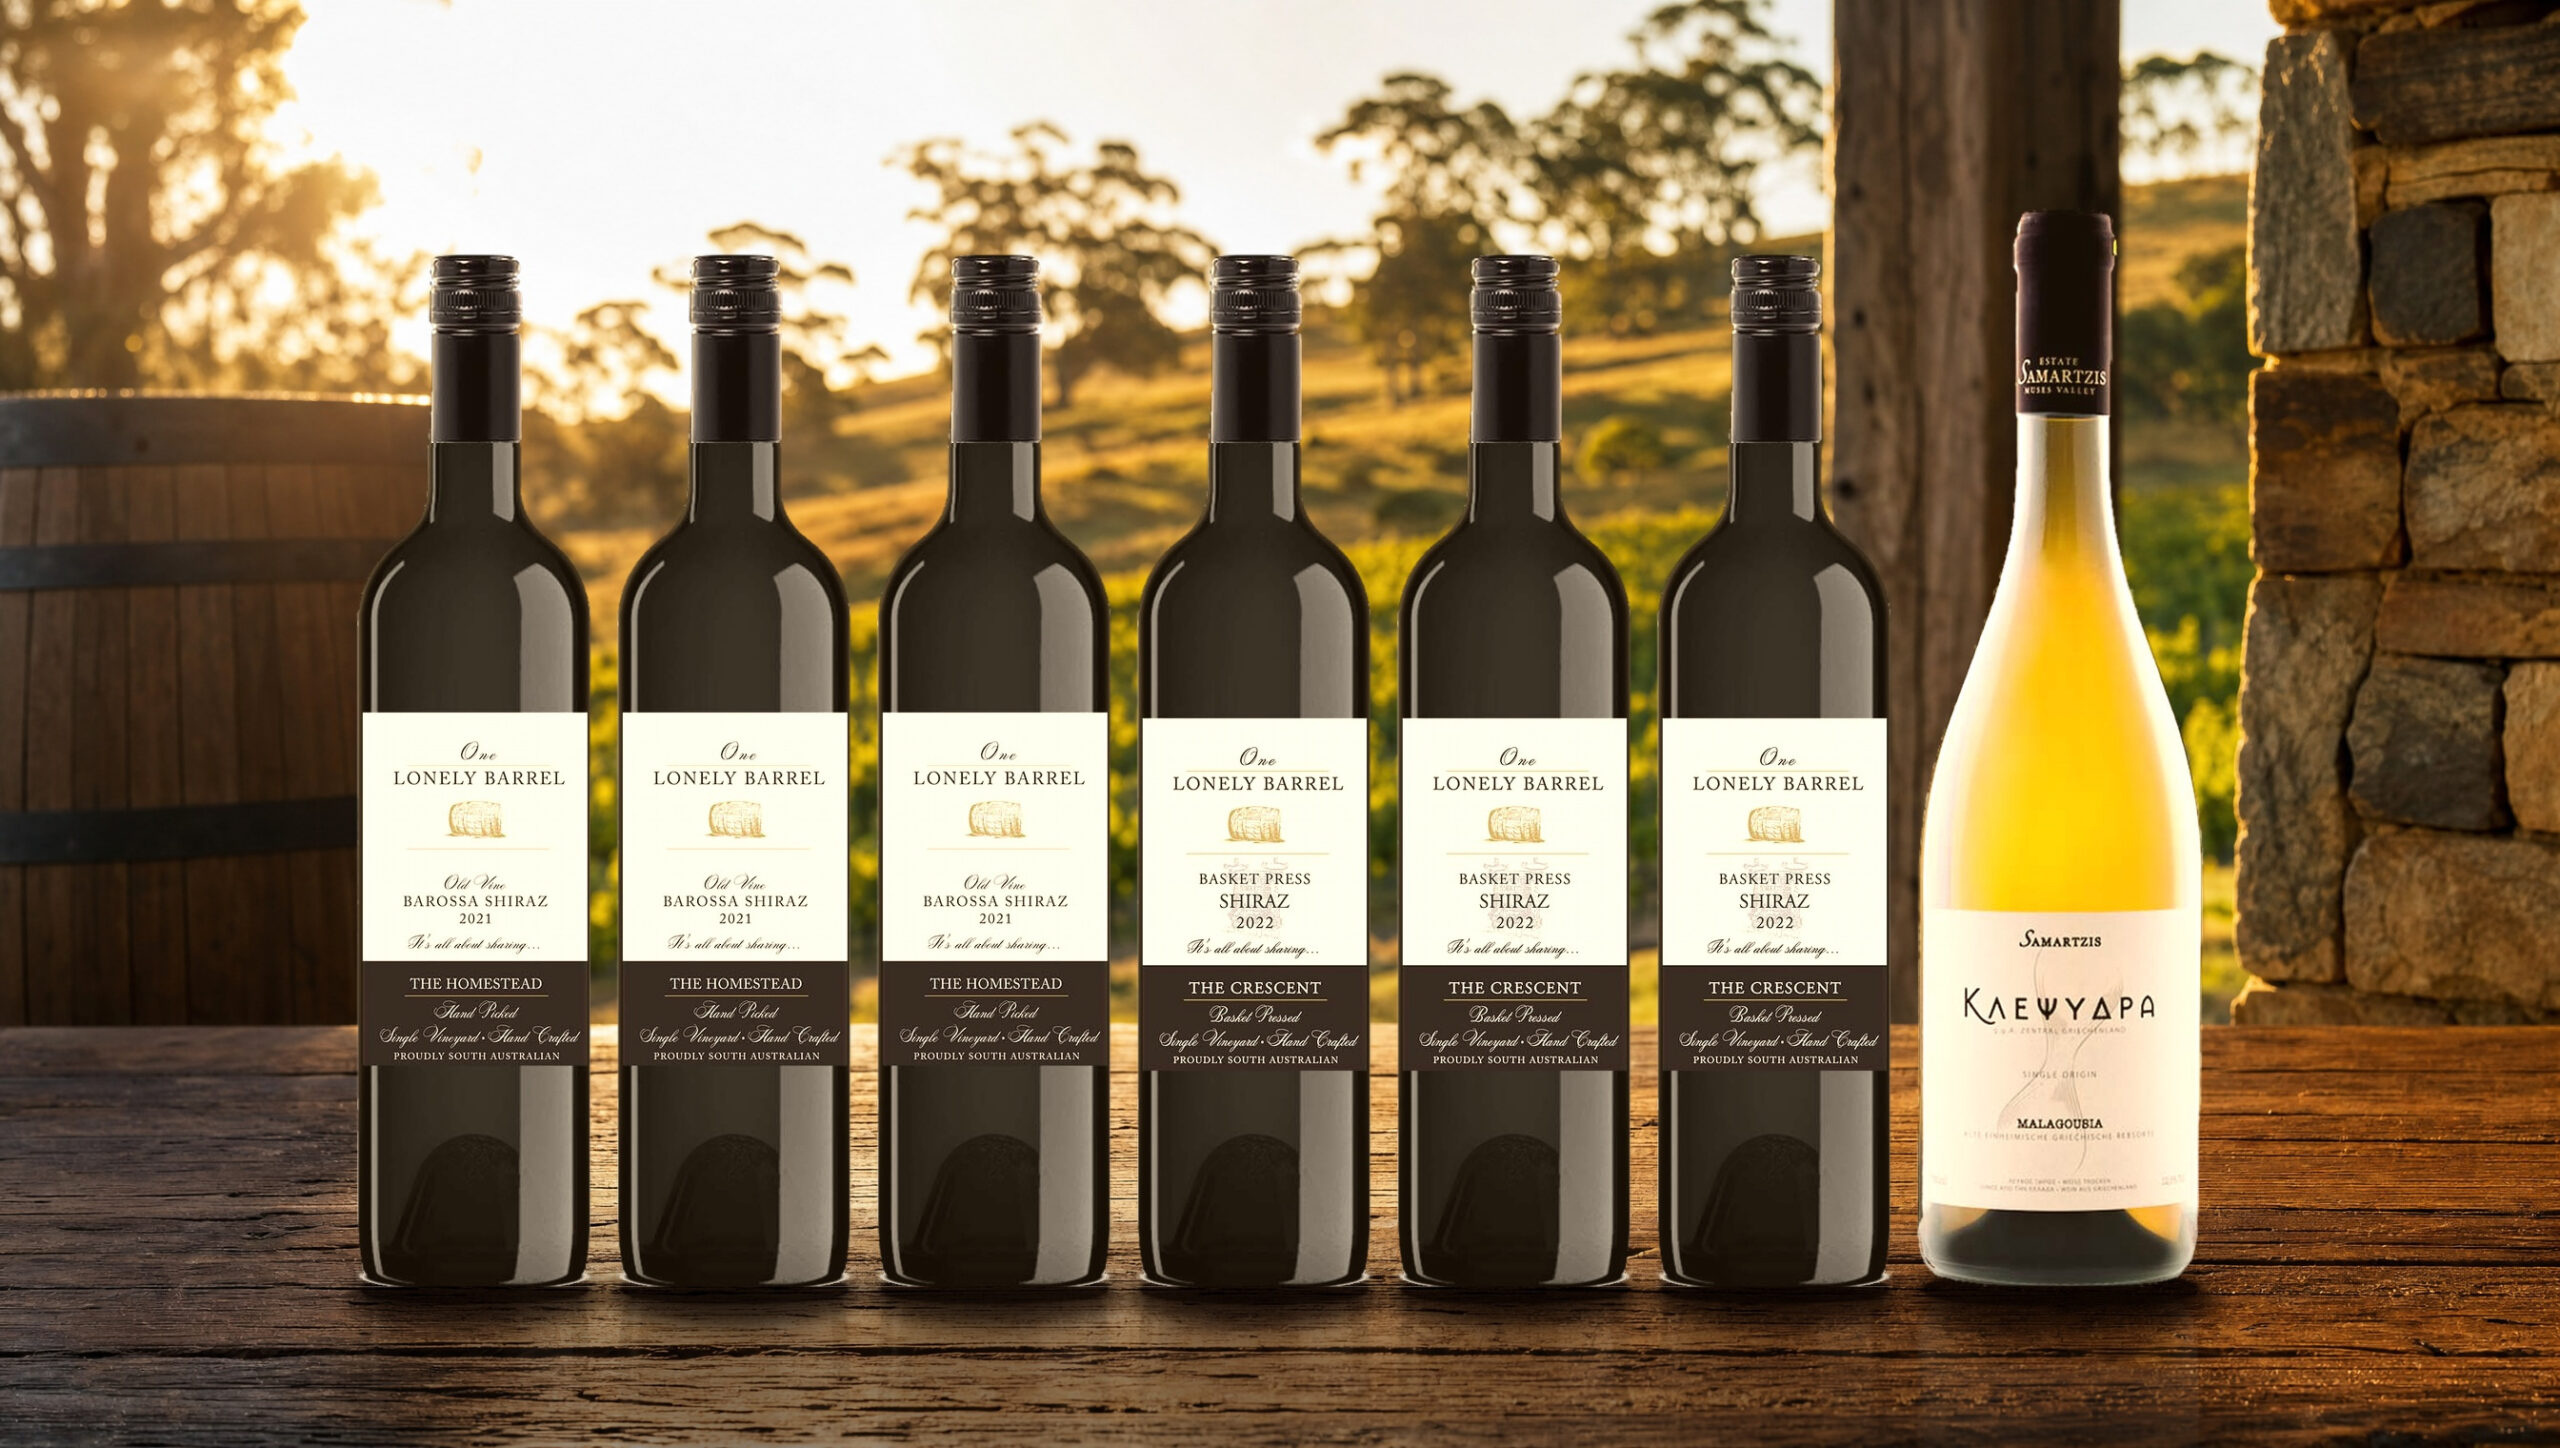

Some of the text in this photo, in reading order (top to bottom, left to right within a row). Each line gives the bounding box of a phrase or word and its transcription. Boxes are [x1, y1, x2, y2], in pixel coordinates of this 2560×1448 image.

[2040, 357, 2079, 366] ESTATE
[2018, 359, 2106, 385] SAMARTZIS
[2025, 386, 2096, 395] MUSES VALLEY
[460, 741, 497, 760] One
[720, 741, 757, 760] One
[980, 741, 1017, 760] One
[1239, 746, 1276, 766] One
[1499, 746, 1536, 766] One
[1759, 746, 1796, 766] One
[393, 771, 565, 785] LONELY BARREL
[653, 771, 825, 785] LONELY BARREL
[913, 771, 1085, 785] LONELY BARREL
[1173, 776, 1344, 791] LONELY BARREL
[1433, 776, 1604, 791] LONELY BARREL
[1693, 776, 1864, 791] LONELY BARREL
[444, 874, 506, 890] Old Vine
[704, 874, 766, 890] Old Vine
[964, 874, 1026, 890] Old Vine
[1199, 873, 1311, 885] BASKET PRESS
[1459, 873, 1571, 885] BASKET PRESS
[1719, 873, 1831, 885] BASKET PRESS
[403, 895, 548, 907] BAROSSA SHIRAZ
[663, 895, 808, 907] BAROSSA SHIRAZ
[923, 895, 1068, 907] BAROSSA SHIRAZ
[1219, 893, 1290, 909] SHIRAZ
[1479, 893, 1550, 909] SHIRAZ
[1739, 893, 1810, 909] SHIRAZ
[459, 913, 491, 924] 2021
[719, 913, 751, 924] 2021
[979, 913, 1011, 924] 2021
[1237, 916, 1274, 929] 2022
[1497, 916, 1534, 929] 2022
[1757, 916, 1794, 929] 2022
[408, 933, 431, 949] It's
[434, 937, 453, 949] all
[454, 937, 484, 949] about
[668, 933, 691, 949] It's
[694, 937, 713, 949] all
[714, 937, 744, 949] about
[928, 933, 951, 949] It's
[954, 937, 973, 949] all
[974, 937, 1004, 949] about
[2019, 928, 2102, 948] SAMARTZIS
[1187, 938, 1212, 954] It's
[1214, 941, 1236, 954] all
[1233, 942, 1263, 954] about
[1447, 938, 1472, 954] It's
[1474, 941, 1496, 954] all
[1493, 942, 1523, 954] about
[1707, 938, 1732, 954] It's
[1734, 941, 1756, 954] all
[1753, 942, 1783, 954] about
[410, 977, 542, 990] THE HOMESTEAD
[670, 977, 802, 990] THE HOMESTEAD
[930, 977, 1062, 990] THE HOMESTEAD
[1189, 981, 1322, 995] THE CRESCENT
[1449, 981, 1582, 995] THE CRESCENT
[1709, 981, 1842, 995] THE CRESCENT
[433, 1000, 520, 1019] Hand Picked
[693, 1000, 780, 1019] Hand Picked
[953, 1000, 1040, 1019] Hand Picked
[1209, 1004, 1302, 1023] Basket Pressed
[1469, 1004, 1562, 1023] Basket Pressed
[1729, 1004, 1822, 1023] Basket Pressed
[379, 1024, 581, 1048] Single Vineyard Hand Crafted
[639, 1024, 841, 1048] Single Vineyard Hand Crafted
[899, 1024, 1101, 1048] Single Vineyard Hand Crafted
[1159, 1028, 1359, 1052] Single Vineyard Hand Crafted
[1419, 1028, 1619, 1052] Single Vineyard Hand Crafted
[1679, 1028, 1879, 1052] Single Vineyard Hand Crafted
[393, 1052, 560, 1060] PROUDLY SOUTH AUSTRALIAN
[653, 1052, 820, 1060] PROUDLY SOUTH AUSTRALIAN
[913, 1052, 1080, 1060] PROUDLY SOUTH AUSTRALIAN
[1173, 1055, 1338, 1064] PROUDLY SOUTH AUSTRALIAN
[1433, 1055, 1598, 1064] PROUDLY SOUTH AUSTRALIAN
[1693, 1055, 1858, 1064] PROUDLY SOUTH AUSTRALIAN
[2022, 1070, 2097, 1078] SINGLE ORIGIN
[2017, 1118, 2103, 1130] MALAGOUSIA
